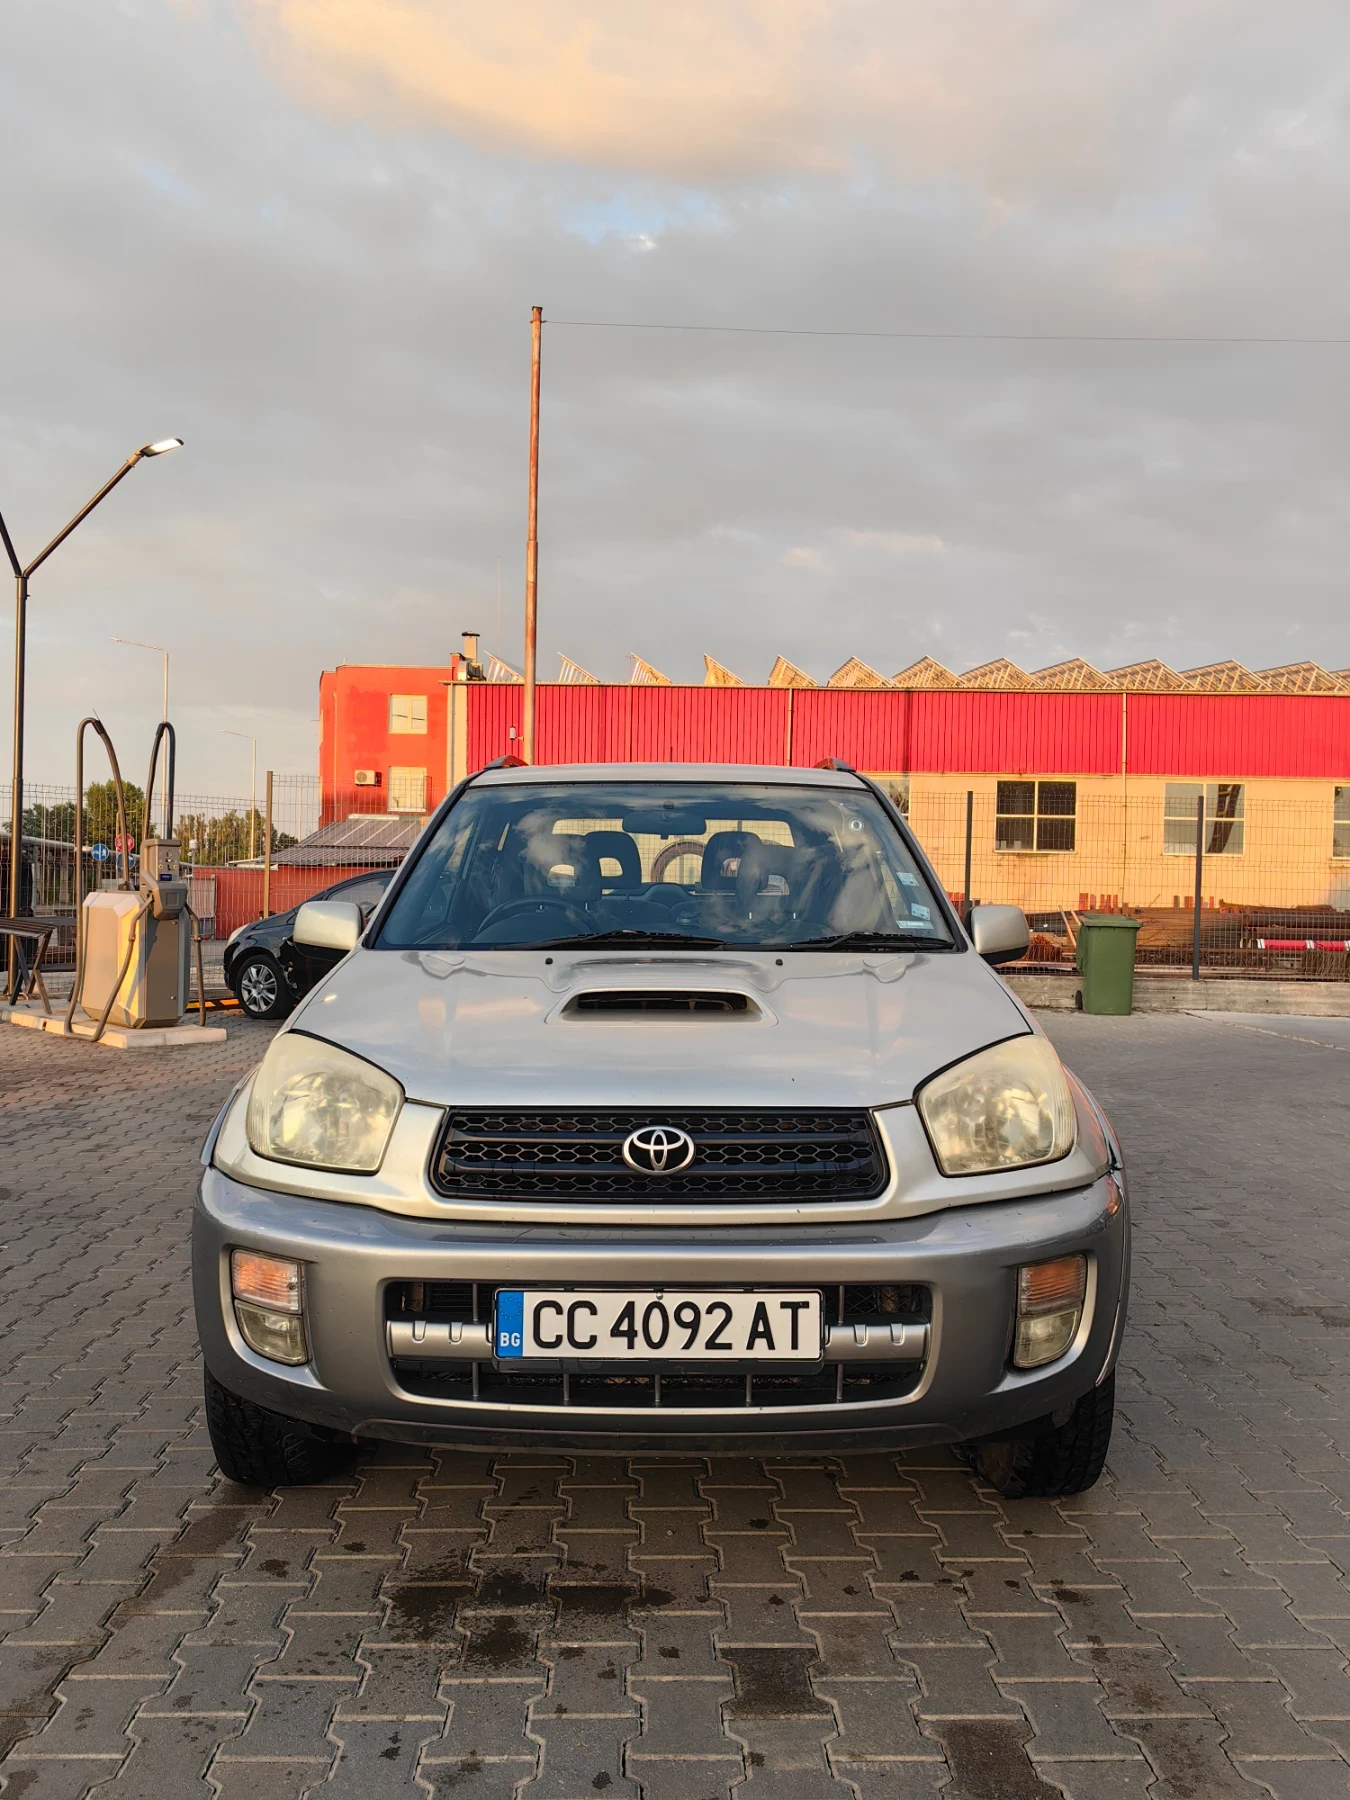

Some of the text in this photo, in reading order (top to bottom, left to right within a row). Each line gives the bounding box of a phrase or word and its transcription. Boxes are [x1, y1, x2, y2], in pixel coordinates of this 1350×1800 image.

[500, 1332, 521, 1347] BG
[533, 1300, 810, 1351] CC 4092 AT
